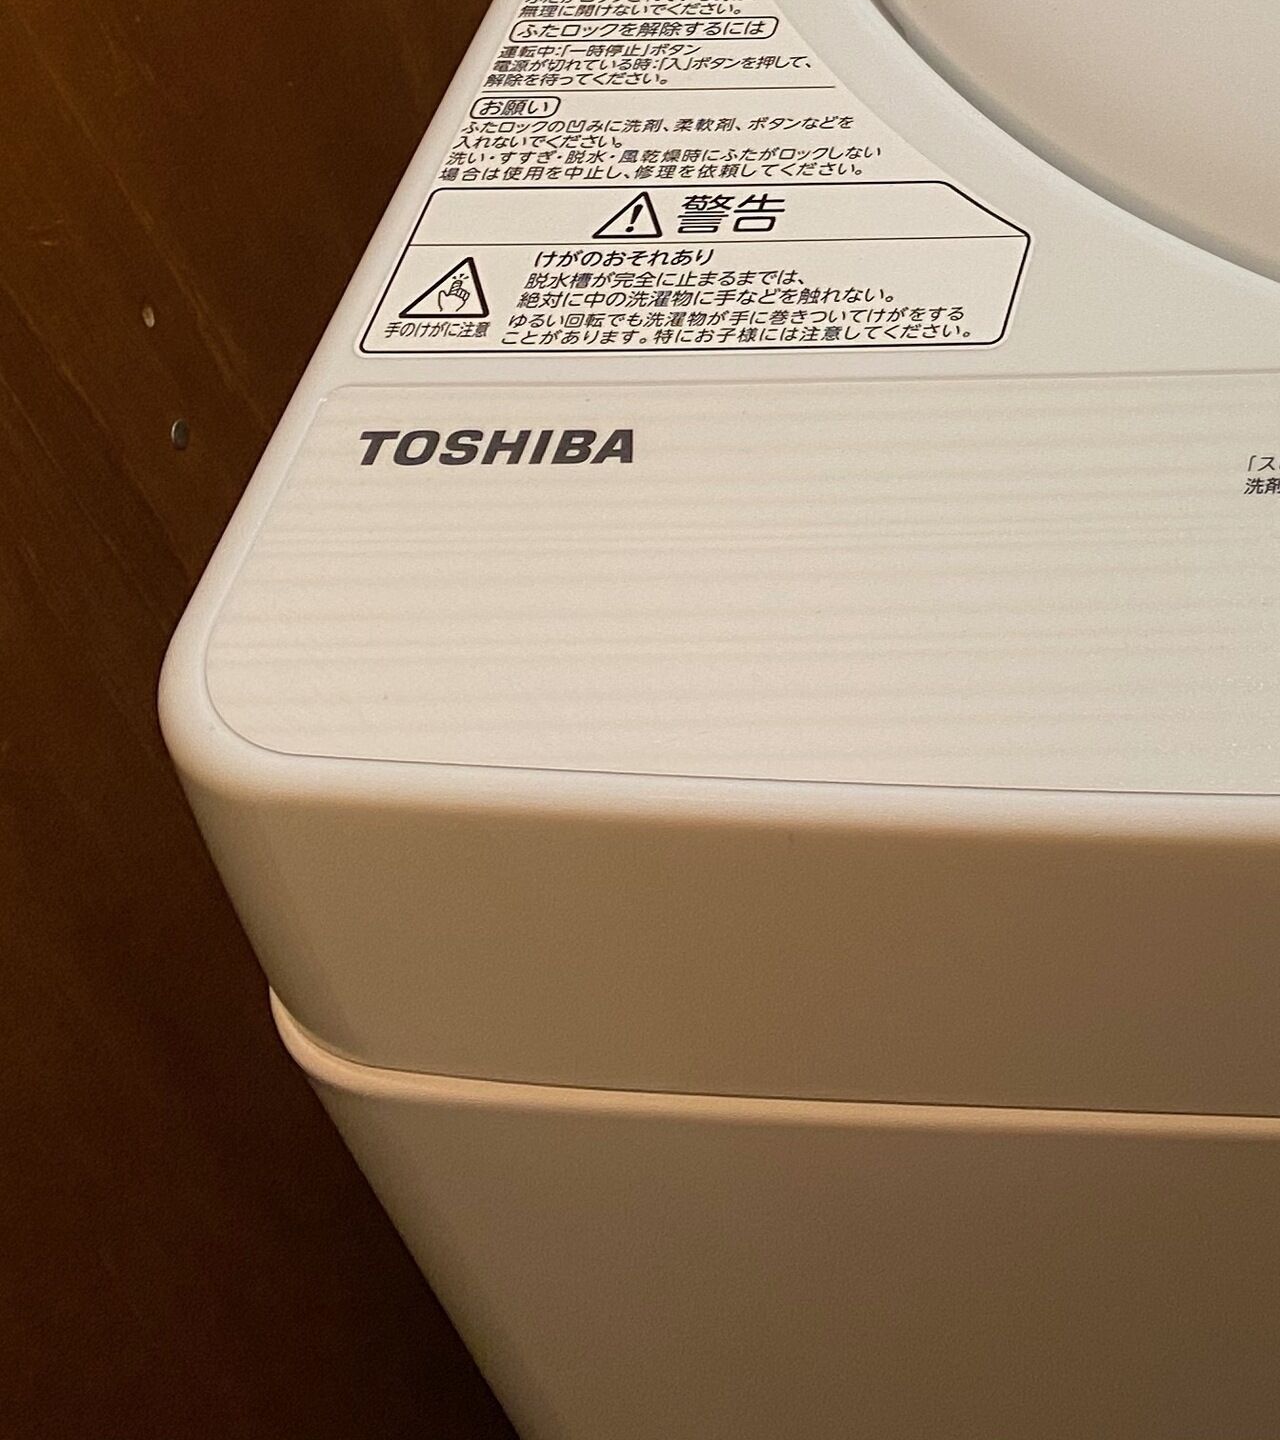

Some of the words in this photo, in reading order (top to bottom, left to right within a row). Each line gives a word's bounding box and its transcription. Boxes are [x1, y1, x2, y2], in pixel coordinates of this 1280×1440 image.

[520, 3, 744, 17] 無理に開けないでください。
[517, 20, 766, 39] ふたロックを解除するには
[484, 72, 671, 87] 解除を待ってください。
[478, 100, 550, 116] お願い
[461, 117, 855, 133] ふたロックの凹みに洗剤、柔軟剤、ボタンなどを
[454, 134, 625, 150] 入れないでください。
[676, 193, 785, 234] 警告
[533, 247, 715, 268] けがのおそれあり
[524, 270, 807, 289] 脱水槽が完全に止まるまでは、
[517, 288, 898, 308] 絶対に中の洗濯物に手などを触れない。
[508, 306, 967, 329] ゆるい回転でも洗濯物が手に巻きついてけがをする
[384, 322, 491, 340] 手のけがに注意
[501, 323, 974, 346] ことがあります。特にお子様には注意してください。
[359, 429, 635, 466] TOSHIBA
